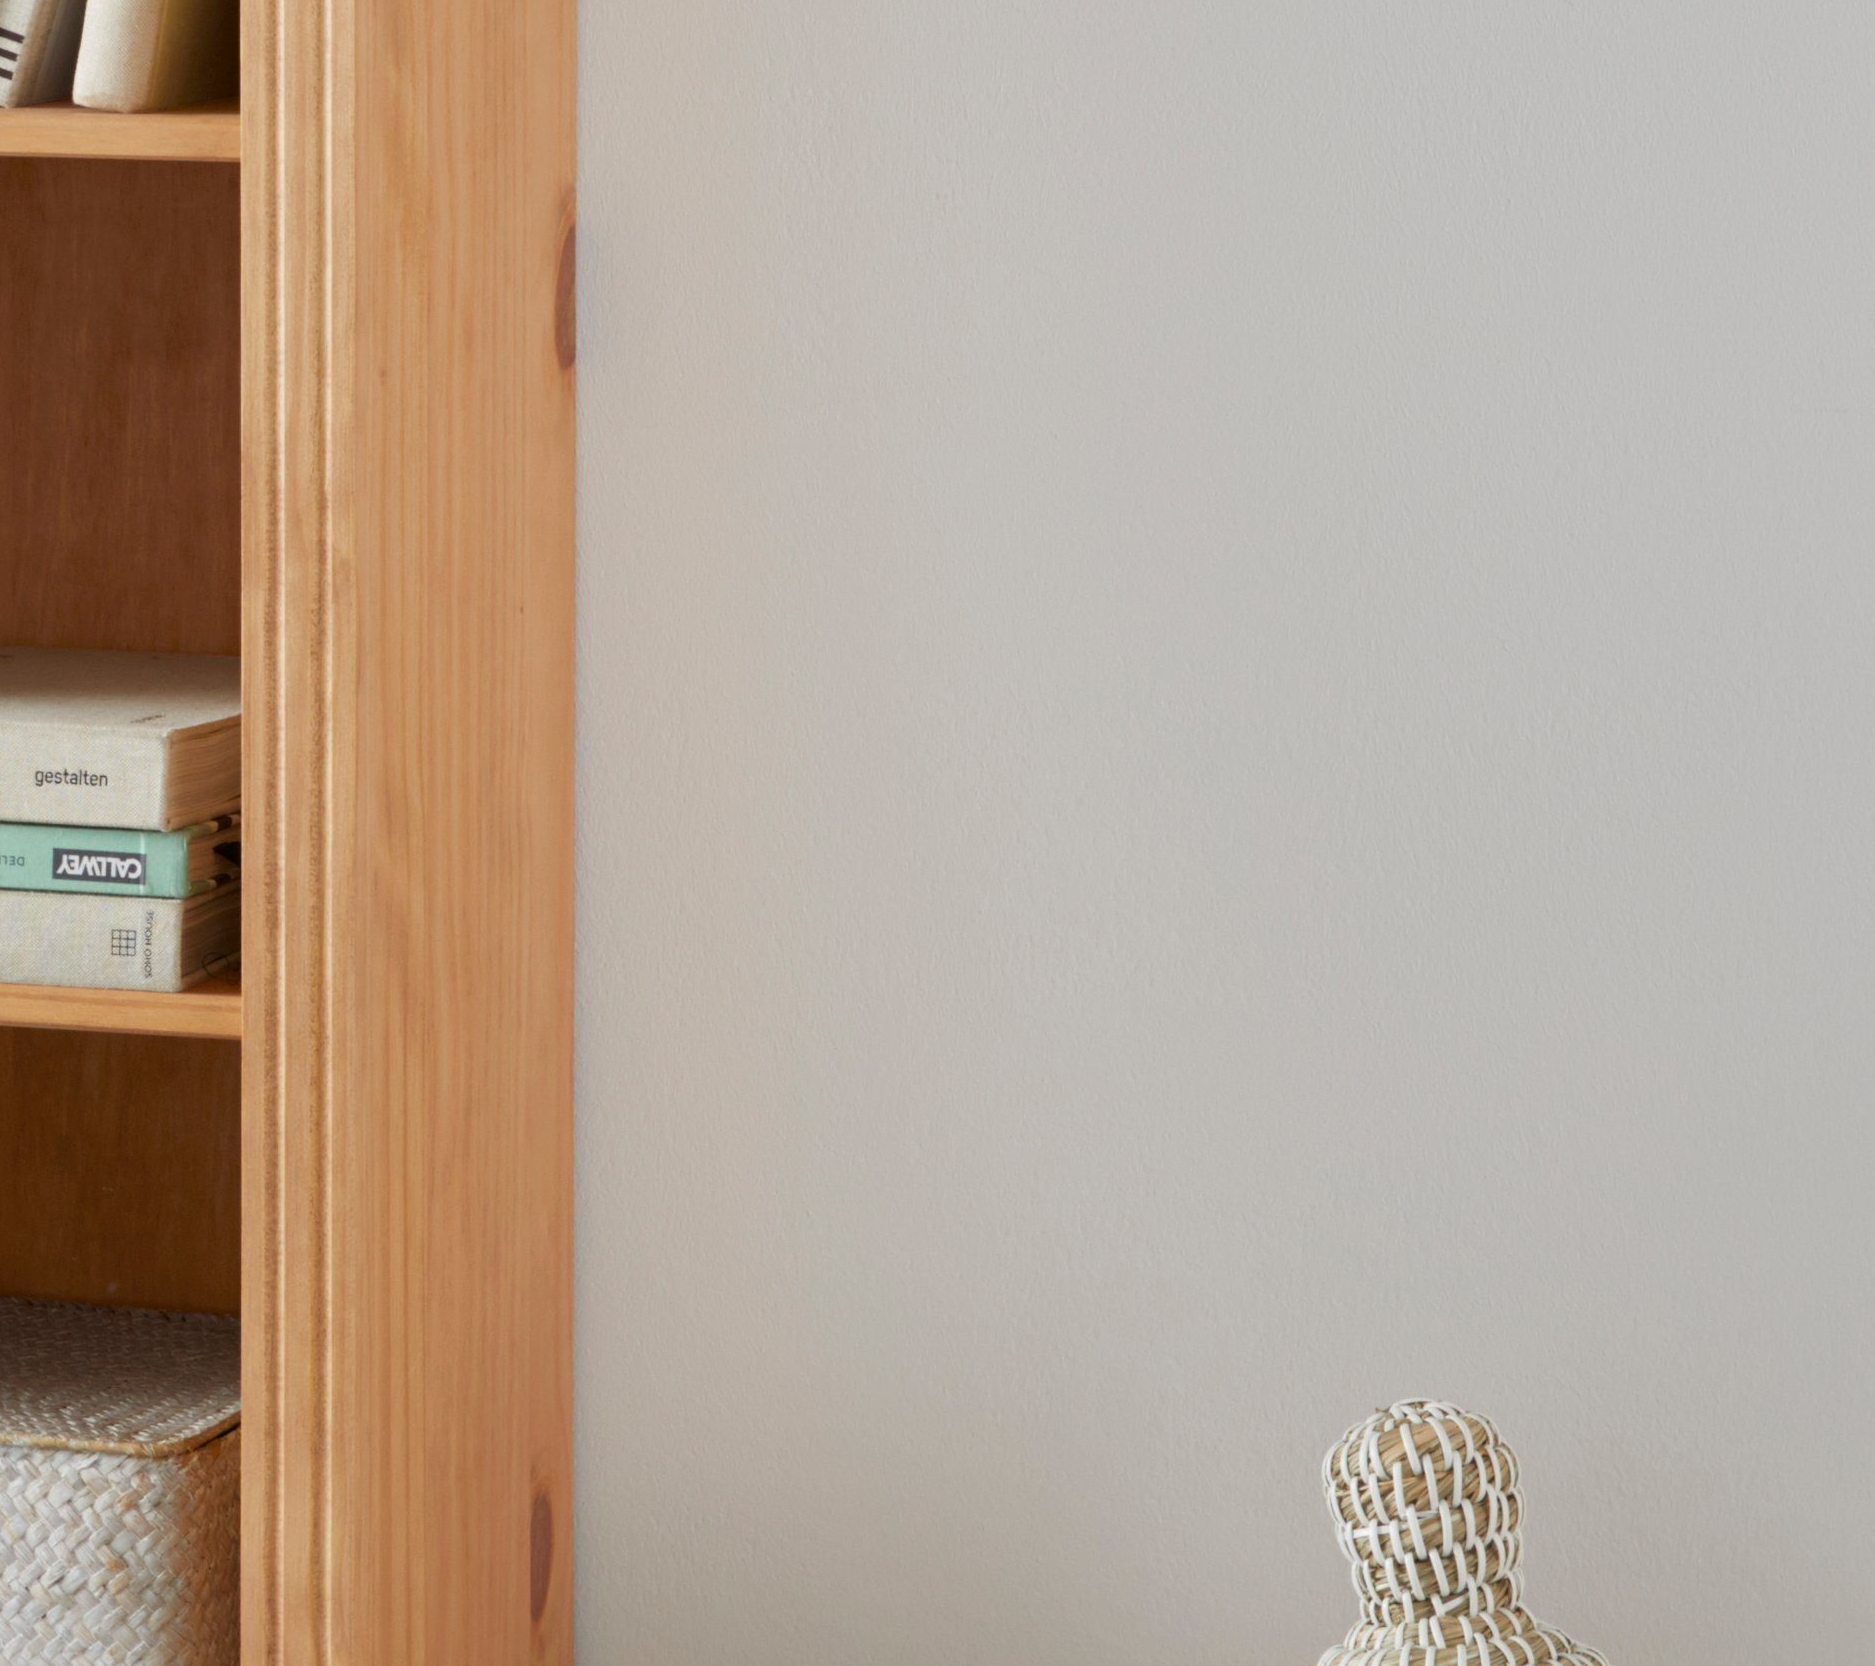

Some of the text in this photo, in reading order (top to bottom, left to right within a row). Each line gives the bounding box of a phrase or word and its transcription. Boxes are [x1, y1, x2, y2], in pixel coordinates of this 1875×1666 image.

[35, 770, 108, 787] gestalten
[56, 854, 142, 879] CALLWEY
[144, 910, 154, 979] SOHO HOUSE
